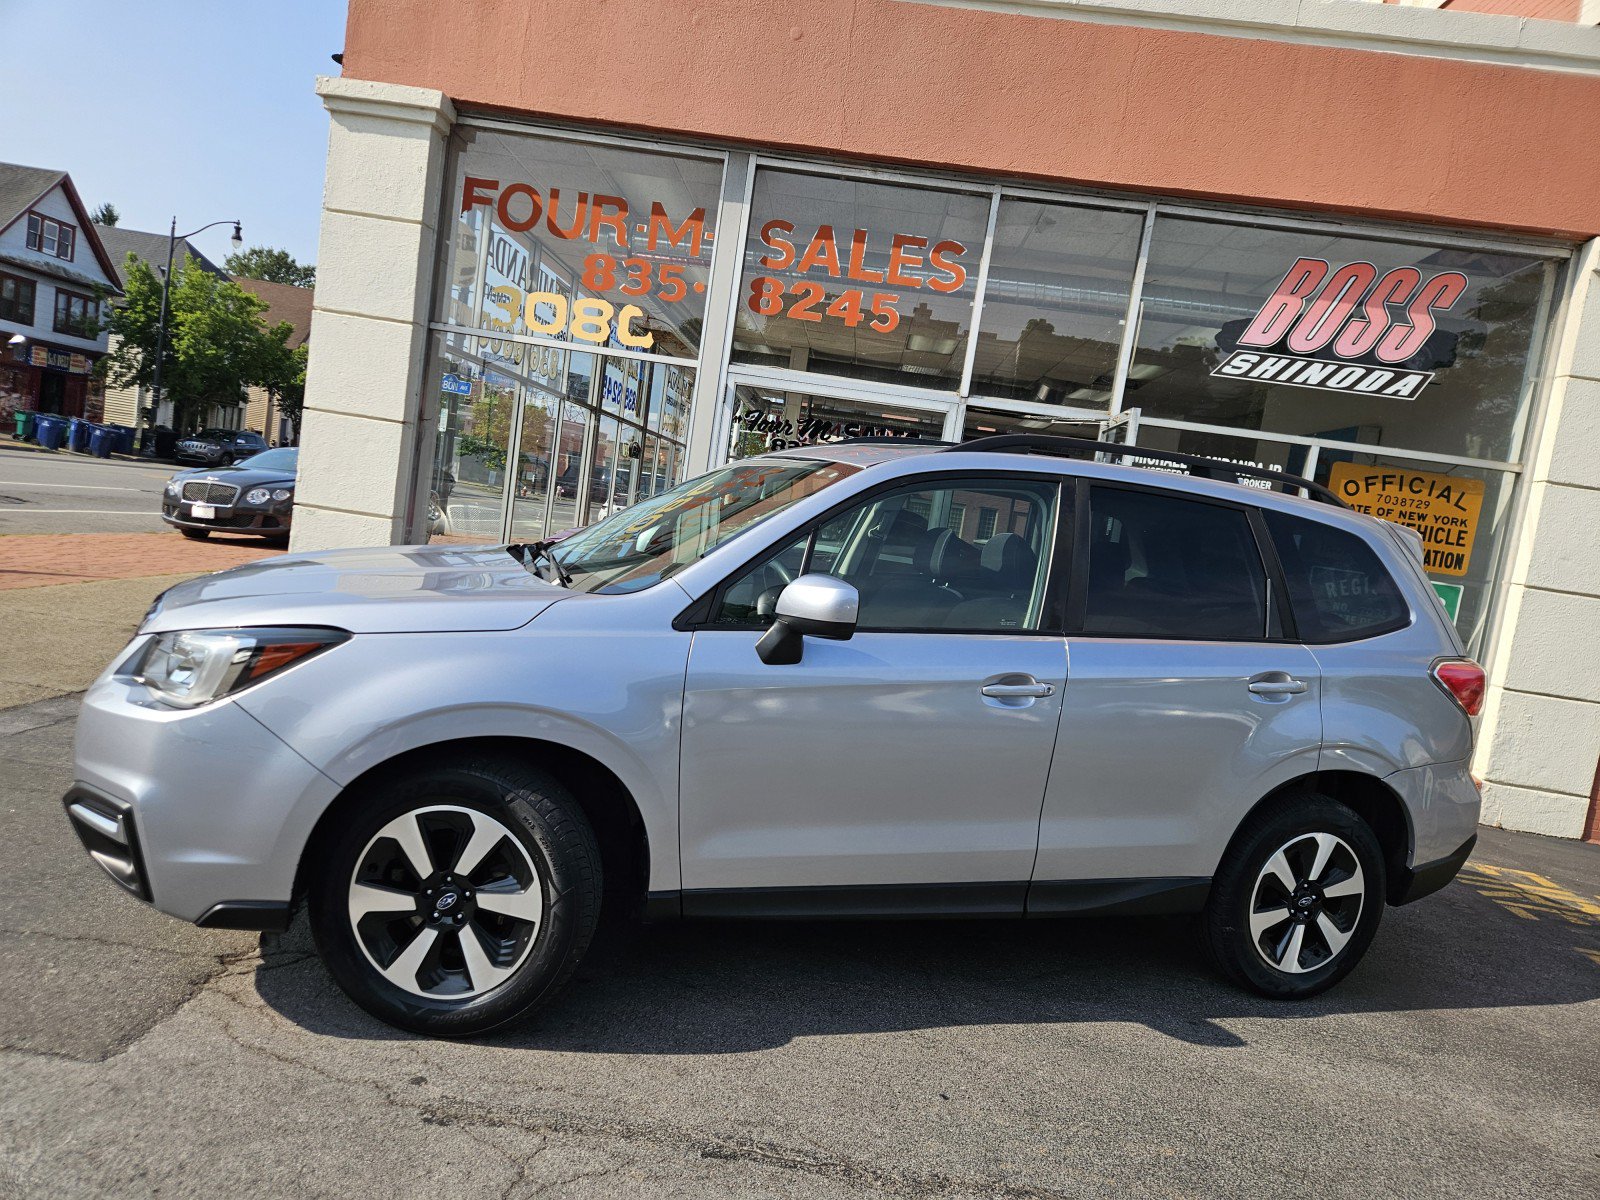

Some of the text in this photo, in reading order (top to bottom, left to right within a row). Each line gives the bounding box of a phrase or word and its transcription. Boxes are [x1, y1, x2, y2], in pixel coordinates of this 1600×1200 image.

[758, 219, 968, 294] SALES
[748, 276, 901, 334] 8245
[1236, 256, 1469, 363] BOSS
[1221, 353, 1424, 397] SHINODA
[1343, 474, 1468, 513] OFFICIAL
[1376, 493, 1431, 509] 7038729
[1350, 503, 1468, 528] ATE OF NEW YORK
[1423, 548, 1465, 571] ATION
